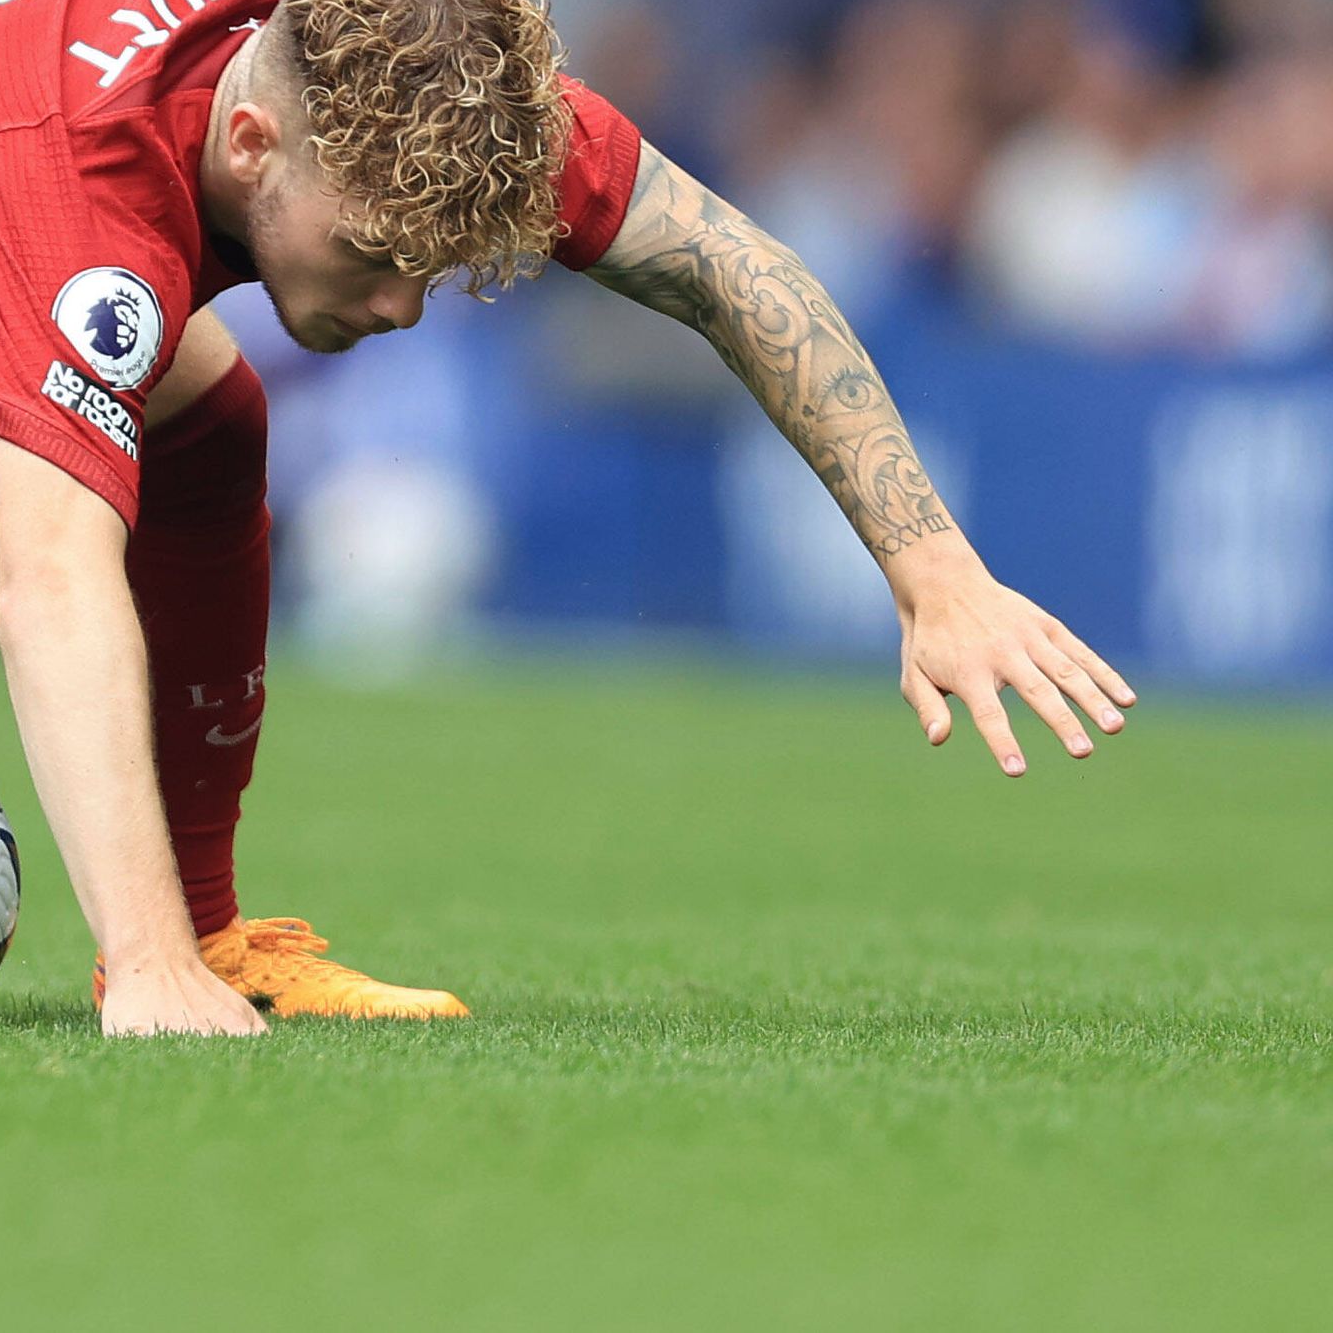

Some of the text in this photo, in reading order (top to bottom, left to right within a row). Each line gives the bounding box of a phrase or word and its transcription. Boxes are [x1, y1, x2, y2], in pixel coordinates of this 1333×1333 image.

[40, 376, 80, 409] for
[46, 359, 137, 439] No room
